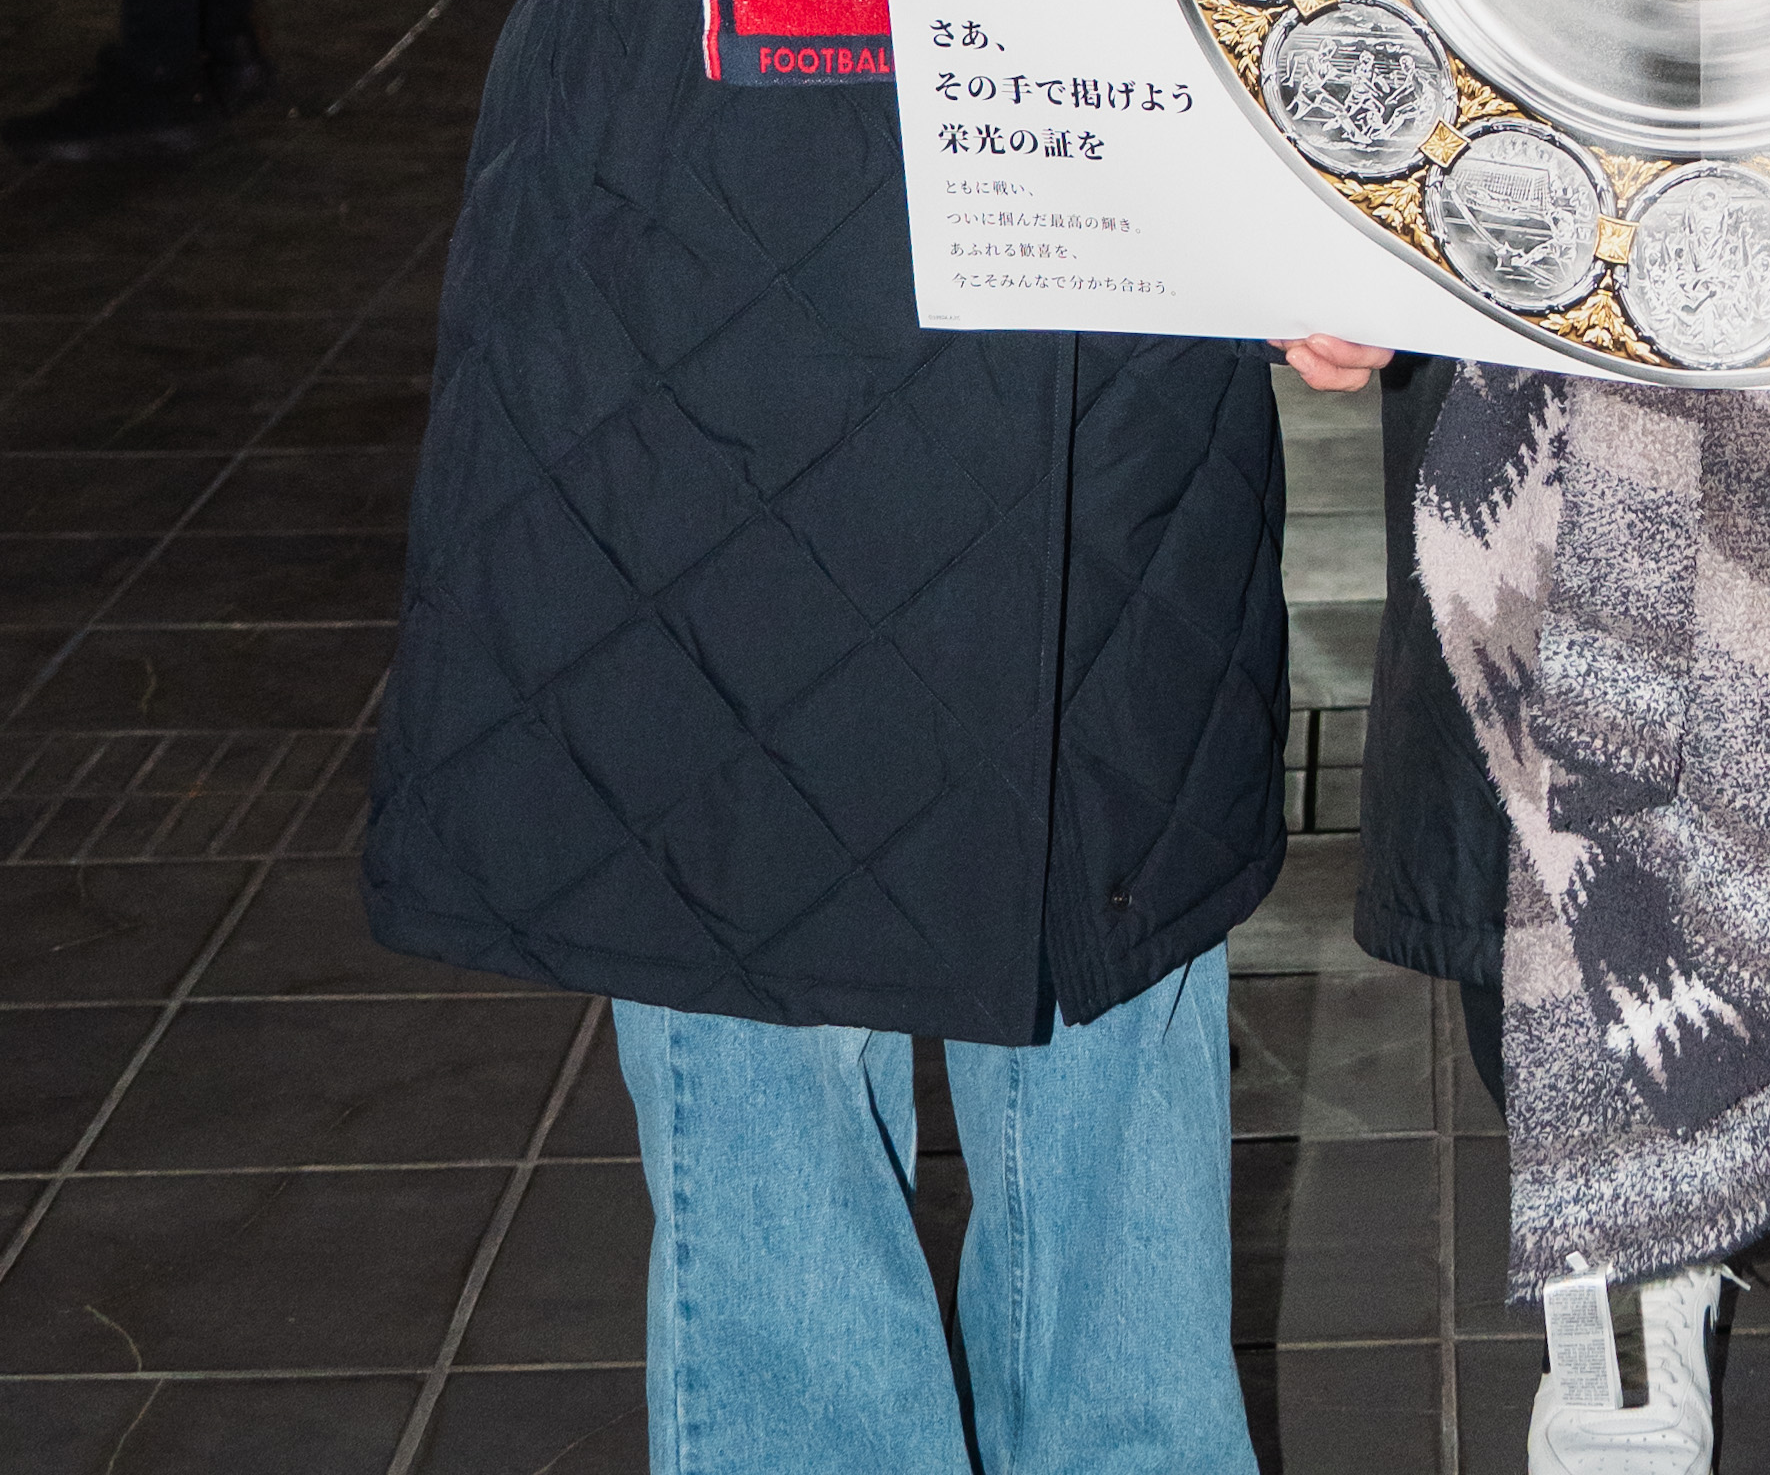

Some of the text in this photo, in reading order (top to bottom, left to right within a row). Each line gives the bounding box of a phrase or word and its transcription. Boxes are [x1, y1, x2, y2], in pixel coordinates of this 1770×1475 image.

[929, 19, 1005, 52] さあ、
[759, 46, 895, 74] FOOTBAL
[934, 71, 1193, 114] その手で掲げよう
[937, 123, 1105, 161] 栄光の証を
[945, 180, 1035, 197] ともに戦い、
[949, 242, 1079, 260] あふれる歓喜を、
[951, 272, 1177, 297] 今こそみんなで分かち合おう。
